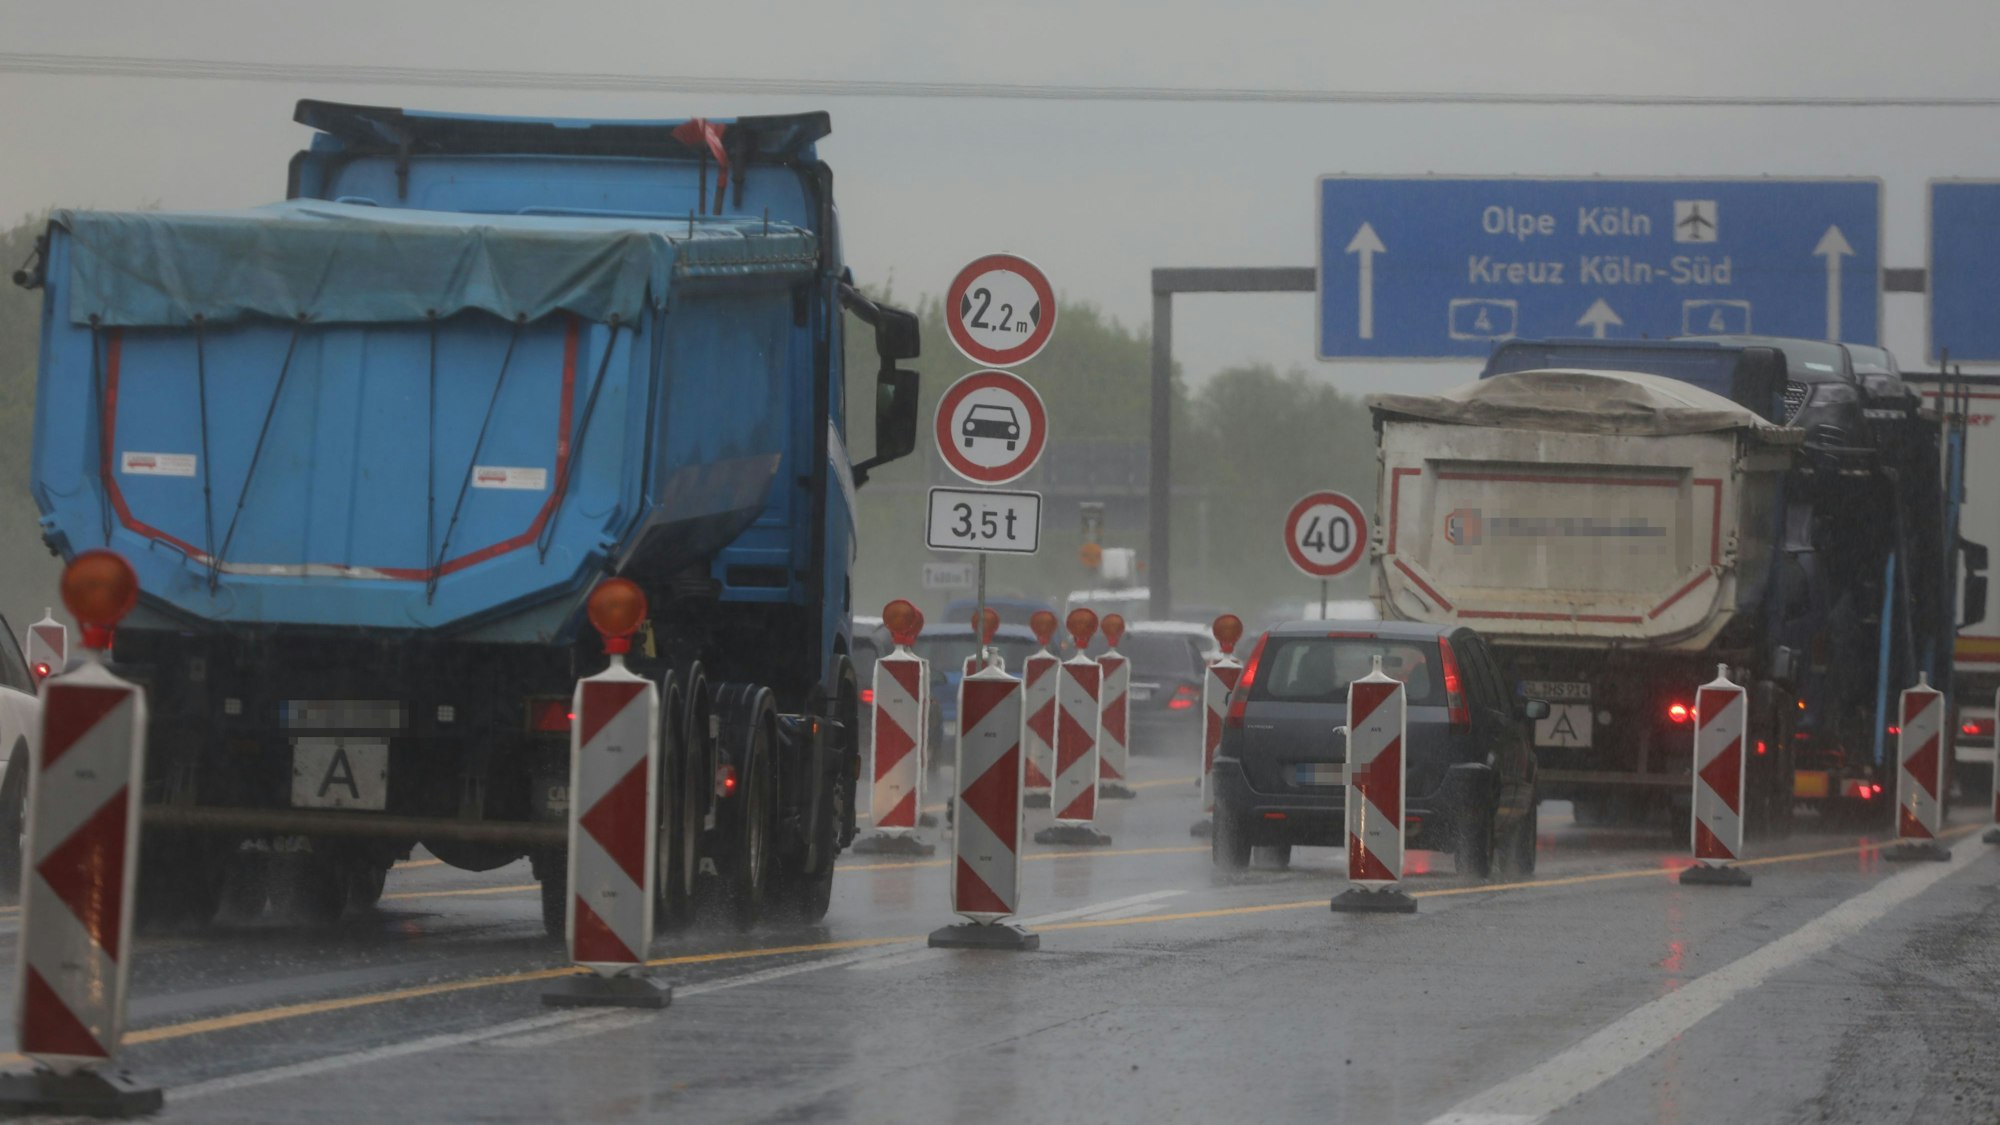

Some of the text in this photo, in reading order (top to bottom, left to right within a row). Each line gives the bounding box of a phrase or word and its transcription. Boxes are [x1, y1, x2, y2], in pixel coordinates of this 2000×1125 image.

[1483, 206, 1650, 242] Olpe Köln
[1468, 255, 1732, 285] Kreuz Köln-Süd
[970, 287, 1028, 334] 2,2 m
[1474, 307, 1492, 331] 4
[1708, 308, 1726, 332] 4
[951, 502, 1017, 541] 3,5 t
[1302, 516, 1350, 553] 40
[1548, 709, 1578, 741] A
[316, 747, 360, 800] A
